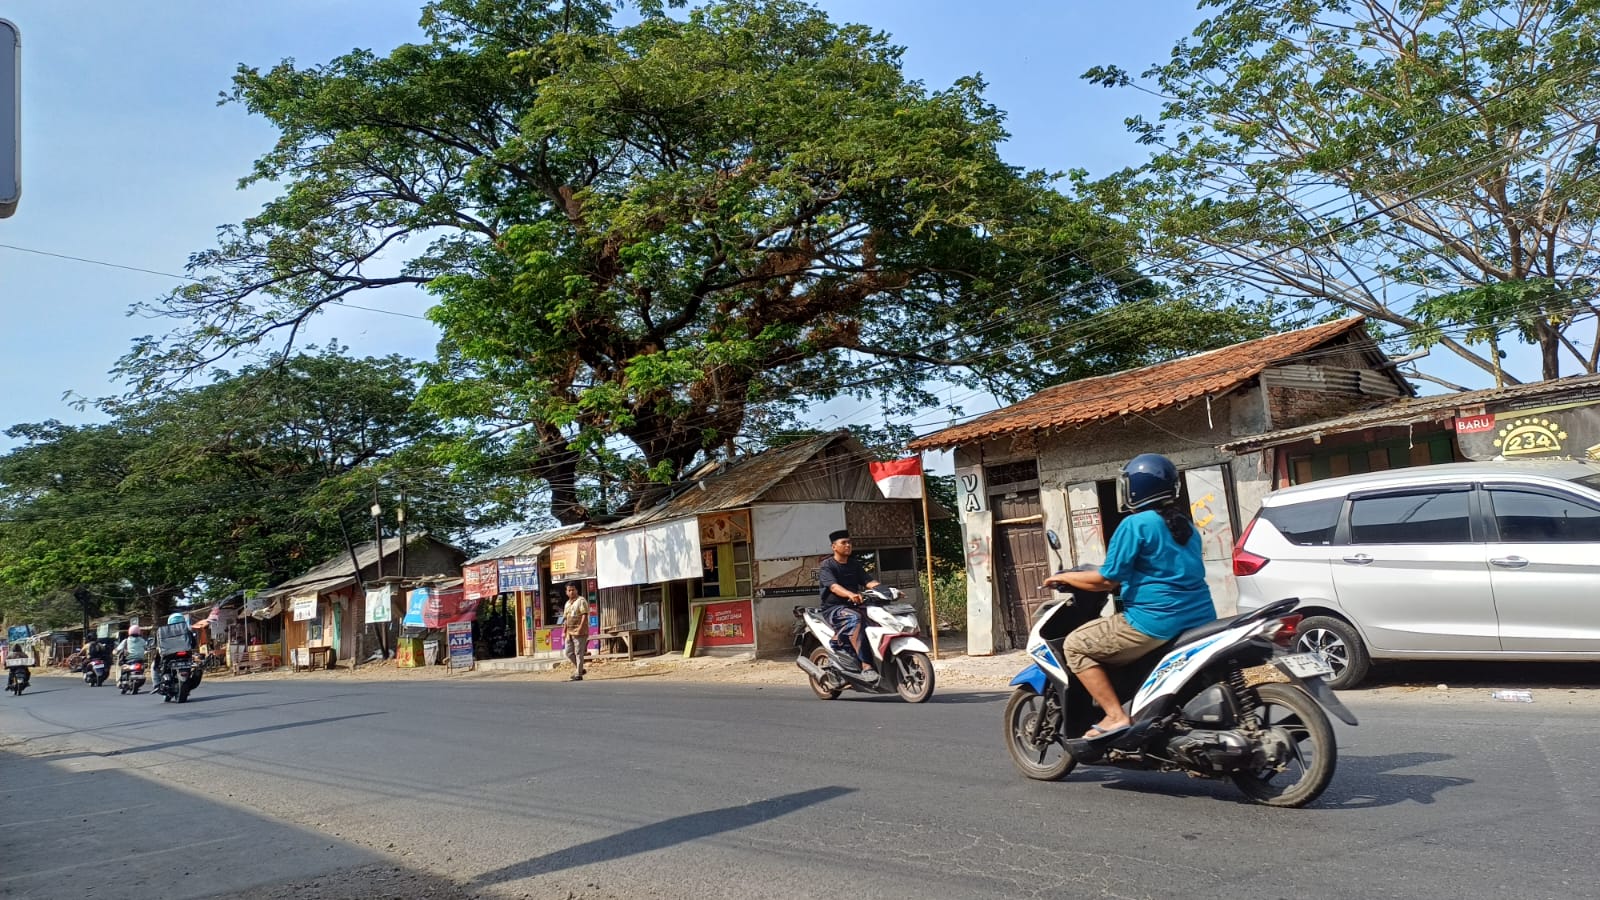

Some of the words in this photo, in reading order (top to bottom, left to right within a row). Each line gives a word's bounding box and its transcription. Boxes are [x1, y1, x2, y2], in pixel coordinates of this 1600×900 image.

[1458, 418, 1489, 430] BARU
[1508, 432, 1551, 451] 234
[450, 636, 472, 646] ATM
